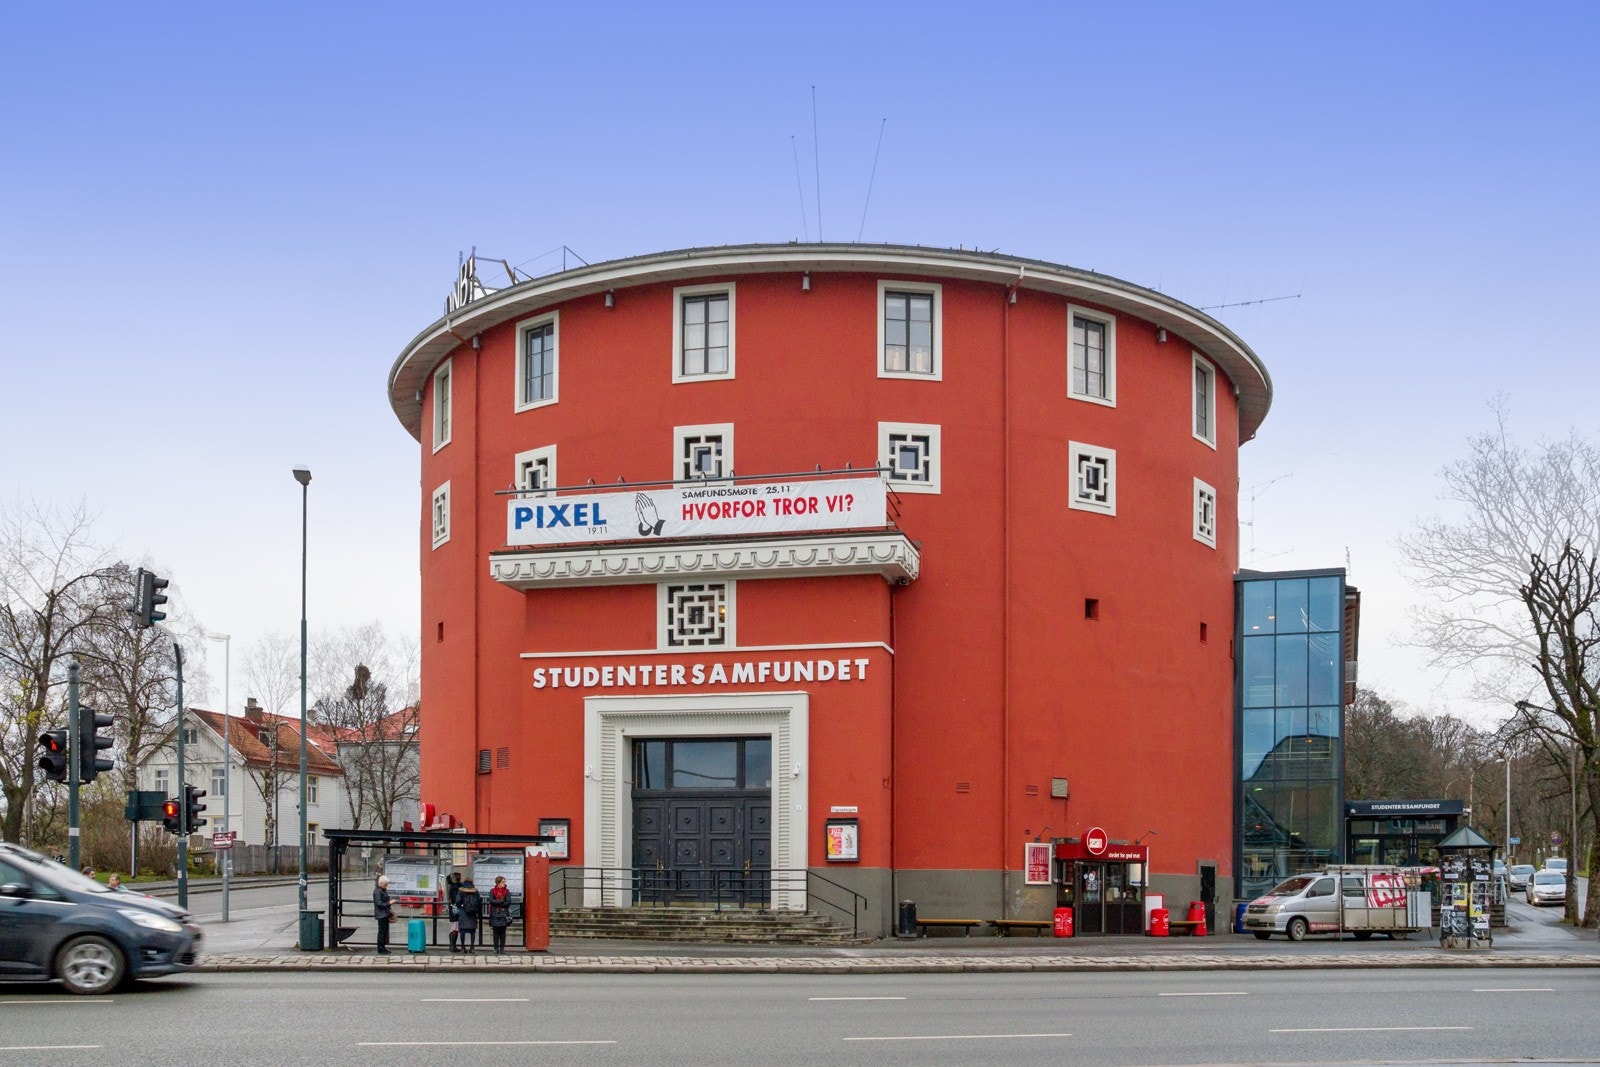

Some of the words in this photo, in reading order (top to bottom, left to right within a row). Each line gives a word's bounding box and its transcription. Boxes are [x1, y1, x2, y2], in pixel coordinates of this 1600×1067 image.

[682, 488, 758, 498] SAMFUNDSMØTE
[766, 486, 790, 494] 25.11
[514, 503, 607, 530] PIXEL
[682, 500, 766, 521] HVORFOR
[773, 497, 819, 515] TROR
[826, 494, 854, 512] VI?
[588, 526, 608, 534] 19.11
[532, 659, 870, 688] STUDENTERSAMFUNDET
